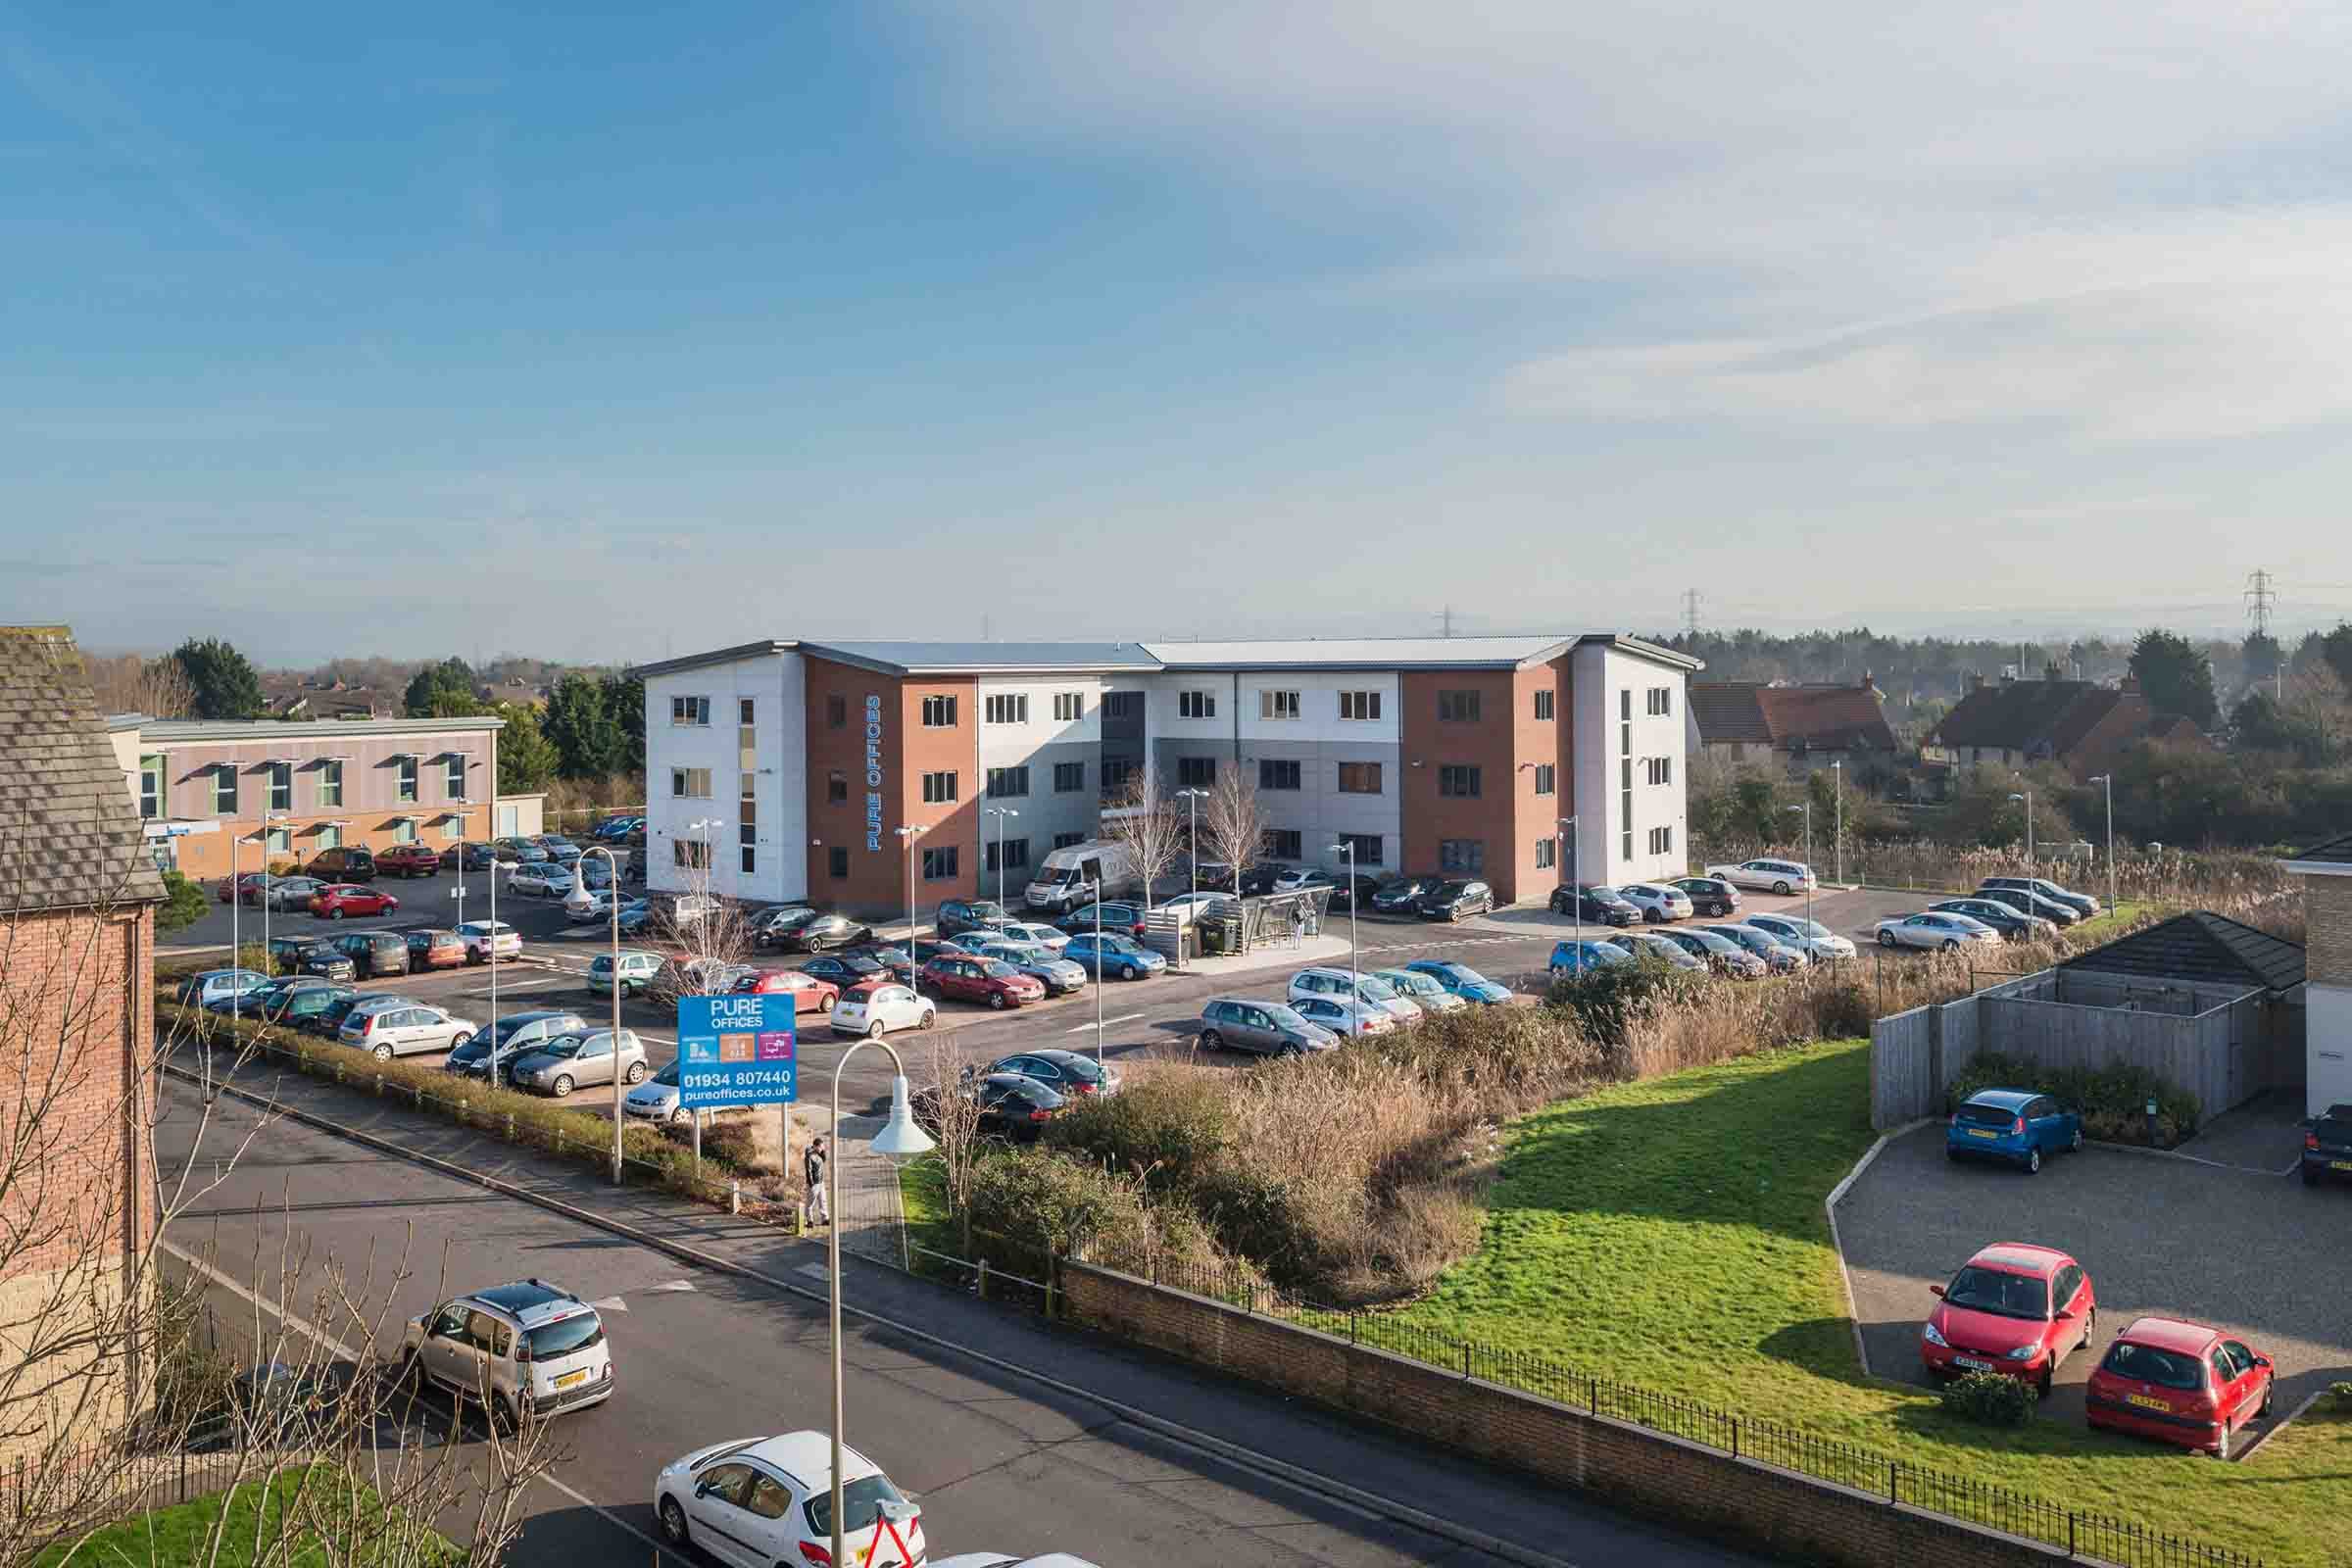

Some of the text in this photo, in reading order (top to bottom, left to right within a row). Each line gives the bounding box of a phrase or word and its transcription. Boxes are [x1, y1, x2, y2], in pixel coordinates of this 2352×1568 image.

[865, 695, 882, 853] PURE OFFICES
[710, 998, 763, 1016] PURE
[710, 1016, 763, 1029] OFFICES
[684, 1070, 791, 1088] 01934 807440
[684, 1085, 791, 1102] pureoffices.co.uk
